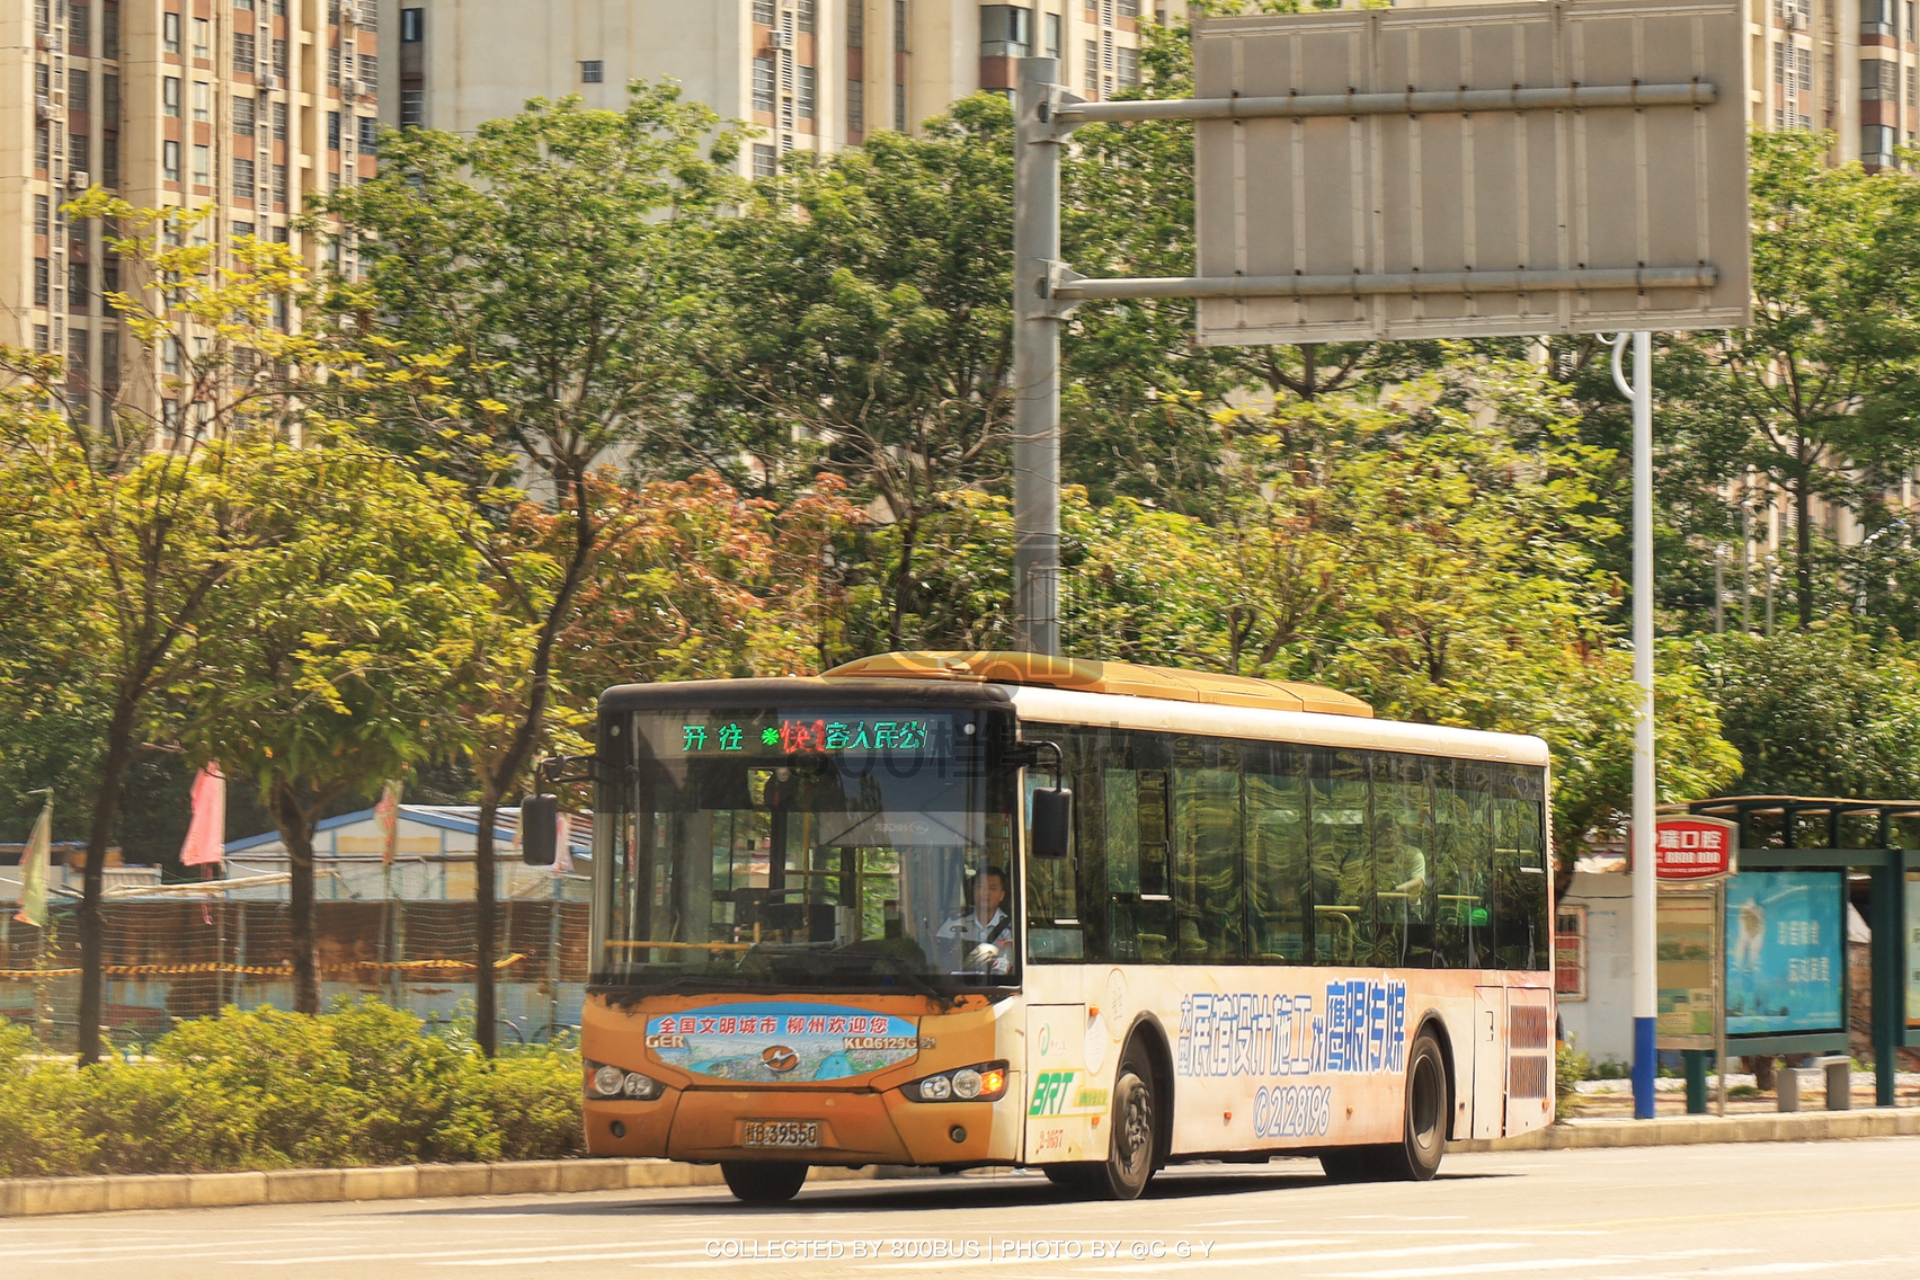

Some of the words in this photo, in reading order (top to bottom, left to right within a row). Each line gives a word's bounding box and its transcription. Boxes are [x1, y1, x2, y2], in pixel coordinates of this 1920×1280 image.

[826, 721, 928, 749] 容人民公
[1655, 829, 1722, 850] 瑞口腔
[658, 1016, 779, 1035] 全国文明城市
[786, 1016, 889, 1035] 柳州欢迎您
[645, 1035, 685, 1048] GER
[1028, 1073, 1074, 1115] BRT
[1268, 1085, 1331, 1137] 2128196
